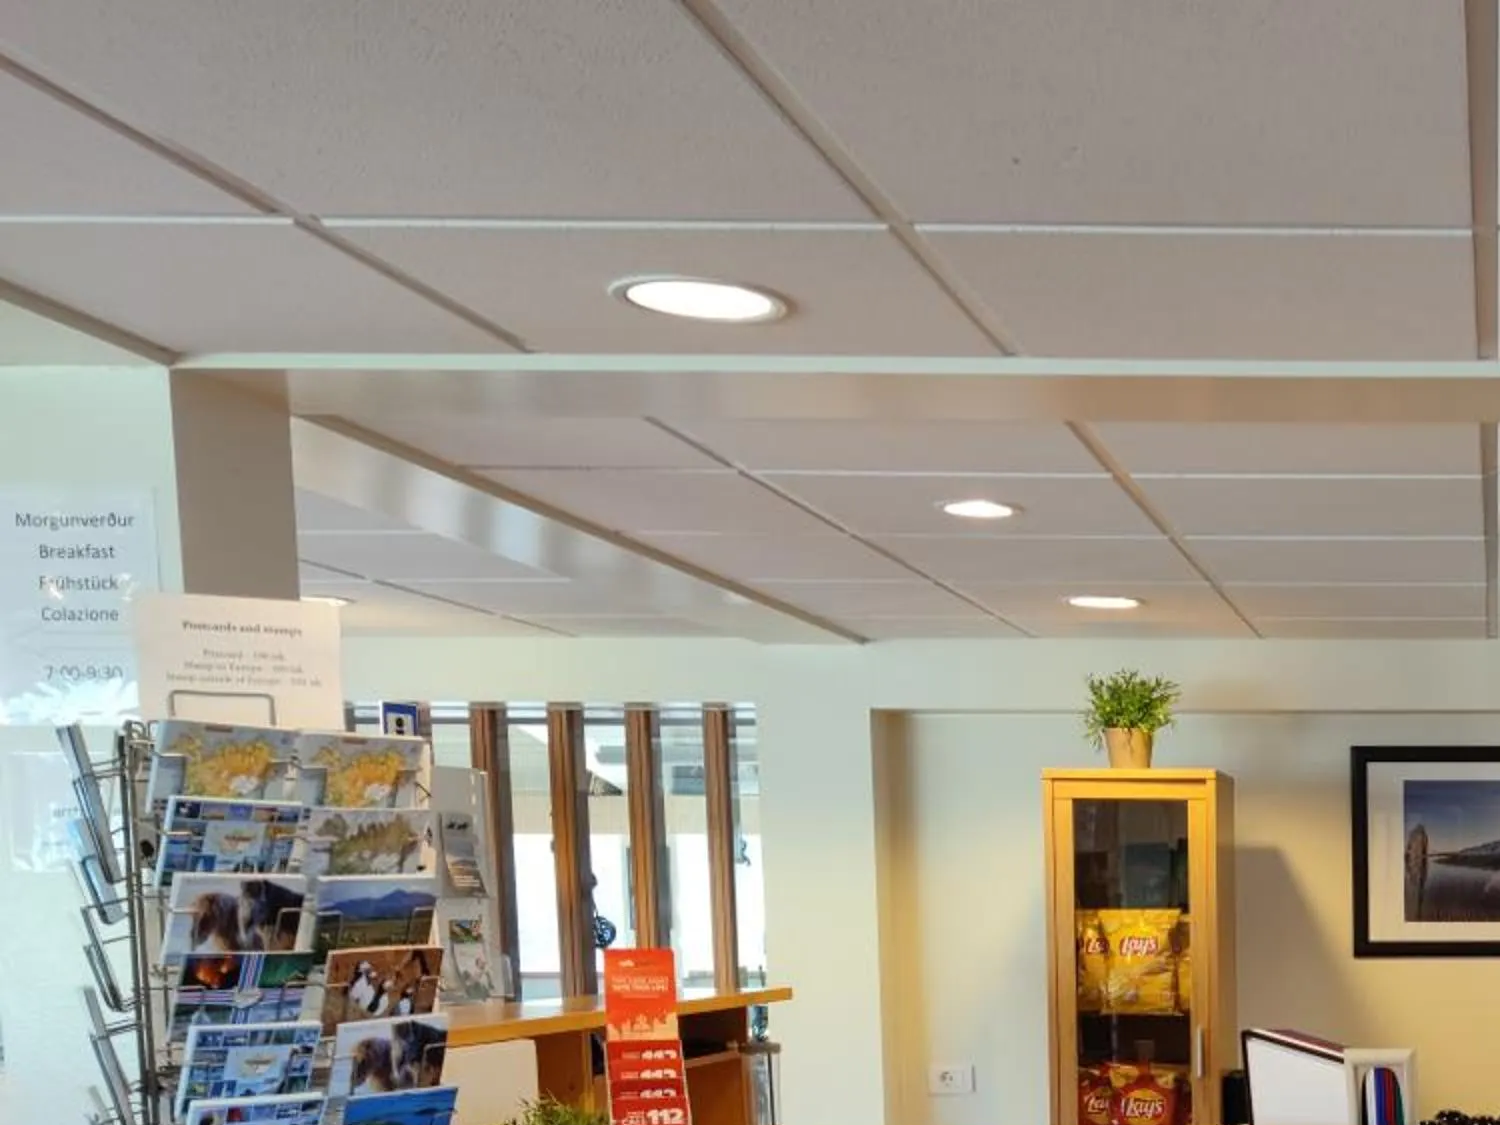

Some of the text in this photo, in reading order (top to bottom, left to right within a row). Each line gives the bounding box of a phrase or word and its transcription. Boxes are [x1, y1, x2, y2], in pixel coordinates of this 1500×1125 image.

[15, 511, 135, 531] Morgunverður
[39, 543, 115, 559] Breakfast
[41, 606, 119, 622] Colazione
[647, 1107, 684, 1125] 112
